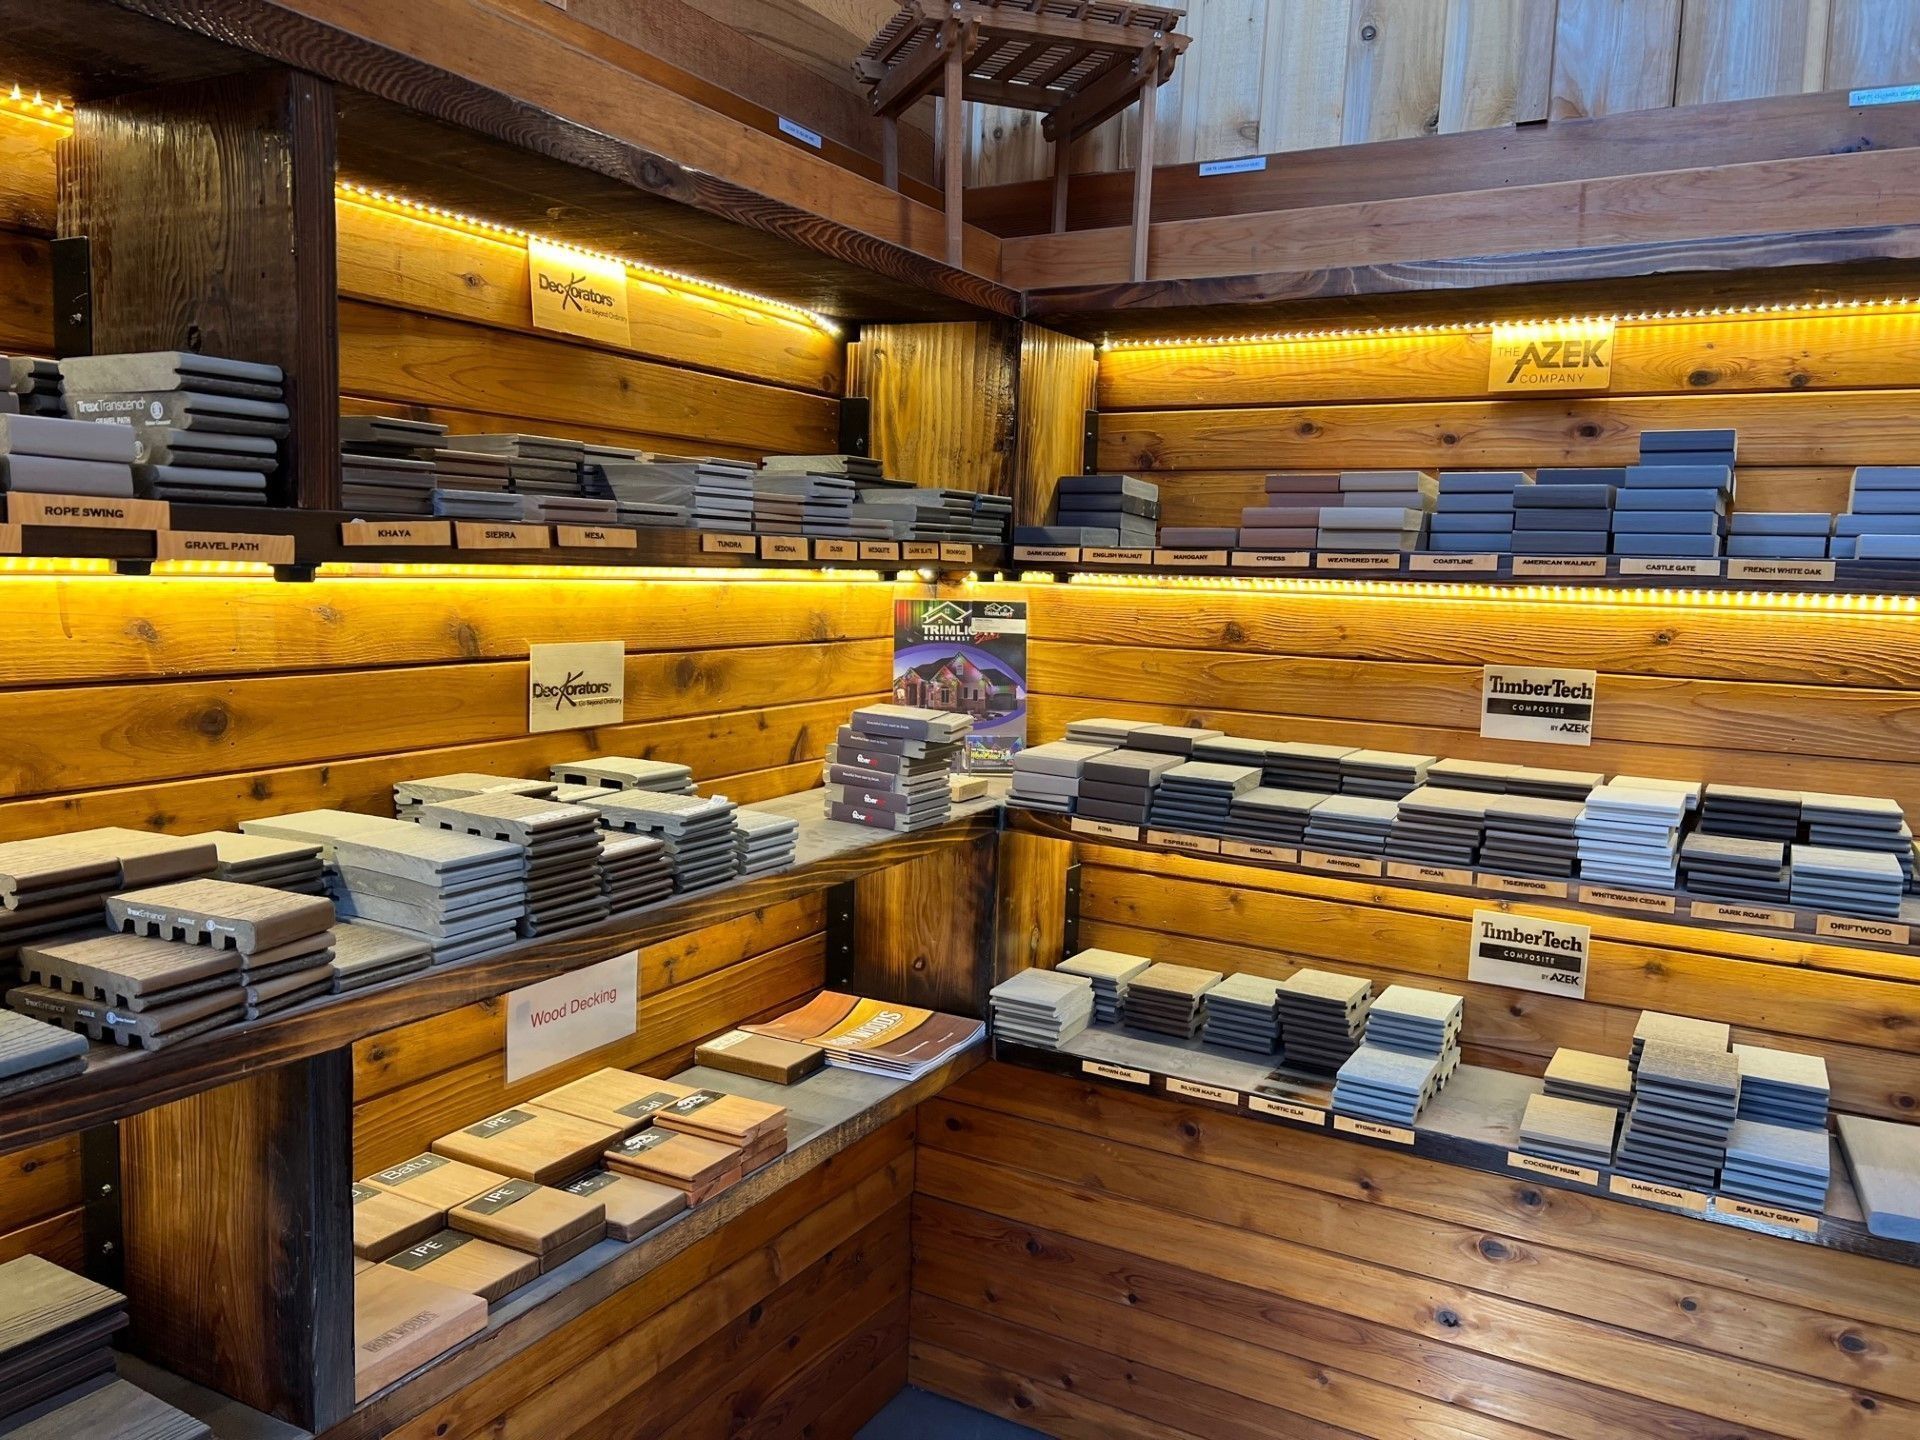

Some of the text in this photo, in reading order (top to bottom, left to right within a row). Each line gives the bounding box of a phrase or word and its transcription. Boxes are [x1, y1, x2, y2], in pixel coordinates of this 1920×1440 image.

[1498, 347, 1520, 356] THE
[1507, 339, 1608, 384] AZEK
[1520, 374, 1584, 384] COMPANY
[44, 506, 124, 518] ROPE SWING
[378, 530, 411, 538] KHAYA
[485, 531, 516, 539] SIERRA
[584, 531, 605, 540] MESA
[185, 540, 259, 551] GRAVEL PATH
[774, 545, 797, 553] SEDONA
[1645, 564, 1675, 572] CASTLE
[1743, 566, 1822, 576] FRENCH WHITE OAK
[922, 625, 977, 636] TRIMLI
[1489, 675, 1593, 699] TimberTech
[1512, 704, 1565, 714] COMPOSITE
[1560, 723, 1589, 733] AZEK
[1163, 839, 1198, 848] ESPRESSO
[1250, 847, 1273, 855] MOCHA
[1326, 859, 1360, 868] ASHWOOD
[1420, 868, 1444, 877] PECAN
[1503, 879, 1546, 890] TIGERWOOD
[1591, 891, 1667, 907] WHITEWASH CEDAR
[1718, 907, 1771, 920] DARK ROAST
[1830, 922, 1892, 936] DRIFTWOOD
[1481, 921, 1582, 952] TimberTech
[1504, 950, 1555, 964] COMPOSITE
[1550, 972, 1580, 986] AZEK
[531, 988, 617, 1028] Wood Decking
[850, 1010, 902, 1038] WOODS
[1098, 1066, 1132, 1078] BROWN OAK
[1180, 1085, 1222, 1098] SILVER MAPLE
[1267, 1104, 1304, 1116] RUSTIC ELM
[483, 1116, 511, 1129] IPE
[1355, 1123, 1392, 1136] STONE ASH
[380, 1158, 432, 1180] Batu
[1523, 1158, 1580, 1177] COCONUT HUSK
[567, 1179, 594, 1193] IPE
[1631, 1183, 1683, 1199] DARK COCOA
[484, 1187, 514, 1202] IPE
[1736, 1205, 1800, 1224] SEA SALT GRAY
[409, 1241, 443, 1257] IPE
